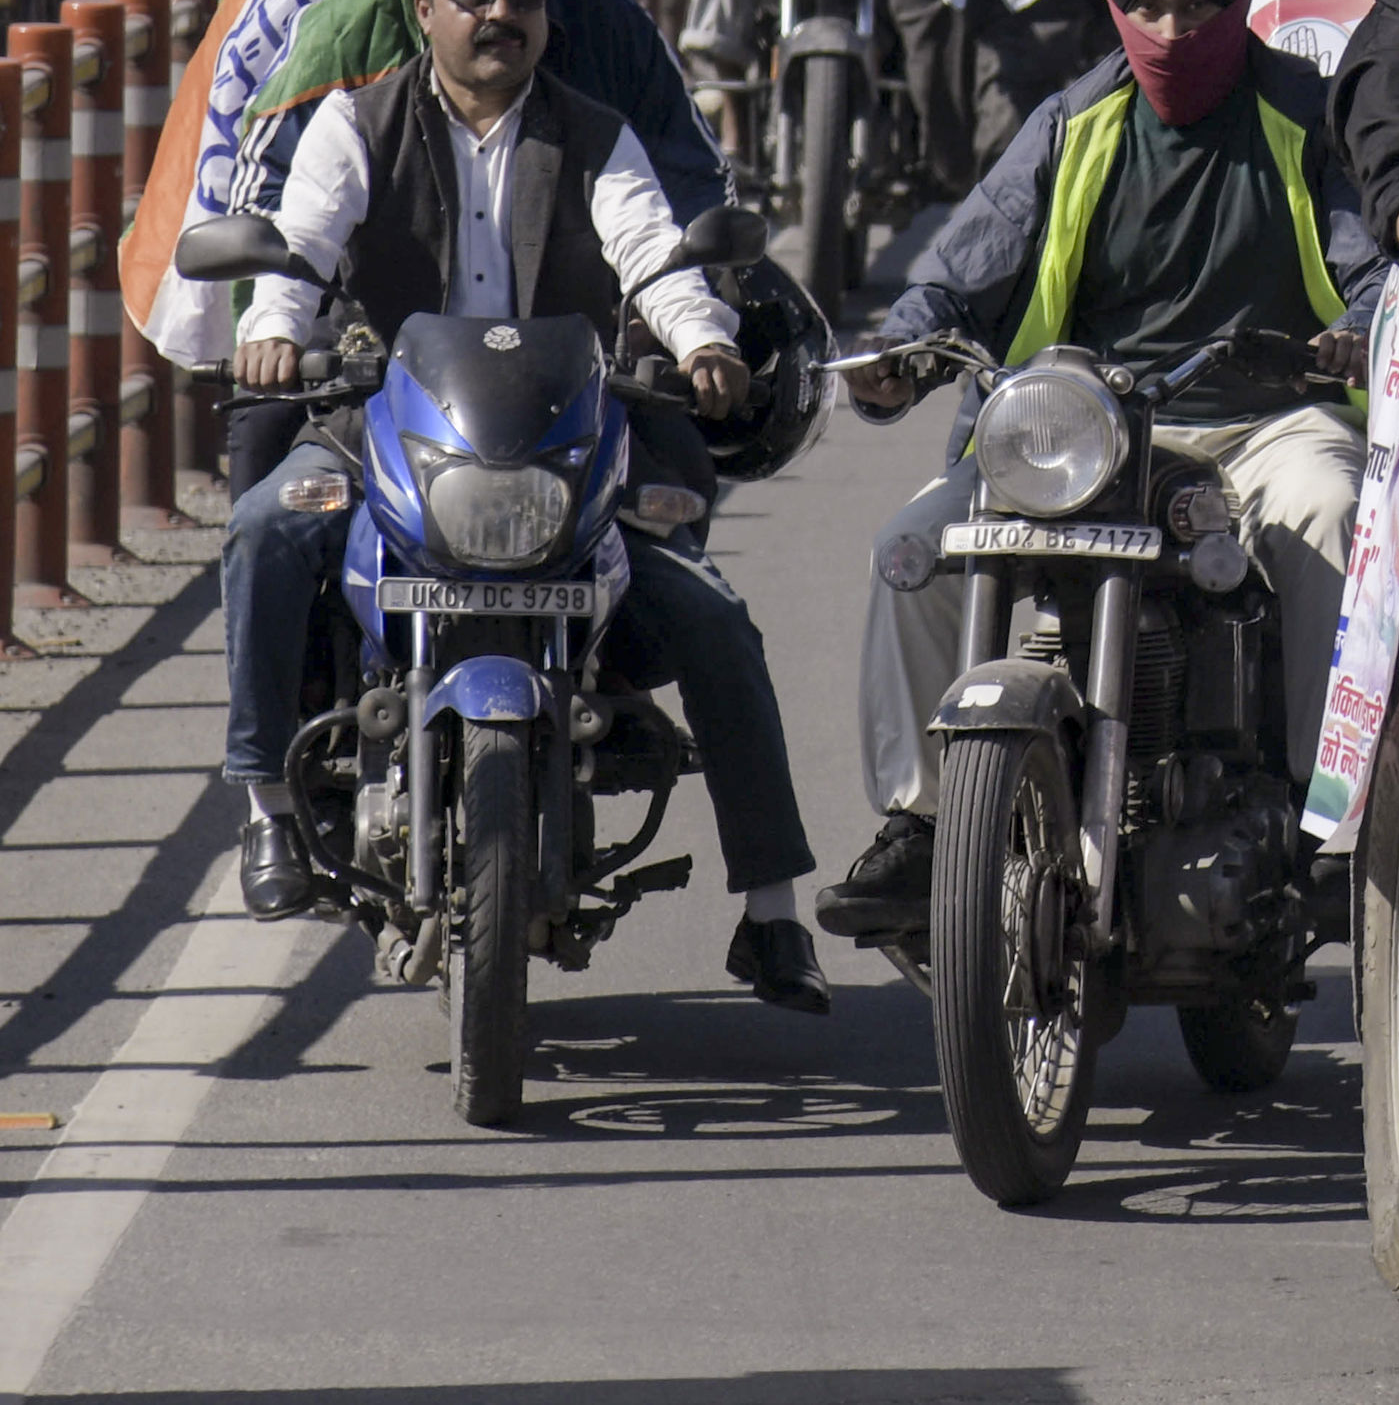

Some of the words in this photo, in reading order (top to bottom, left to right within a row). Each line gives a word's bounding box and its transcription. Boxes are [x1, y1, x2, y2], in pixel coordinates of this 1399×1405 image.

[1088, 528, 1152, 555] 7177
[483, 586, 512, 608] DC
[523, 587, 585, 610] 9798
